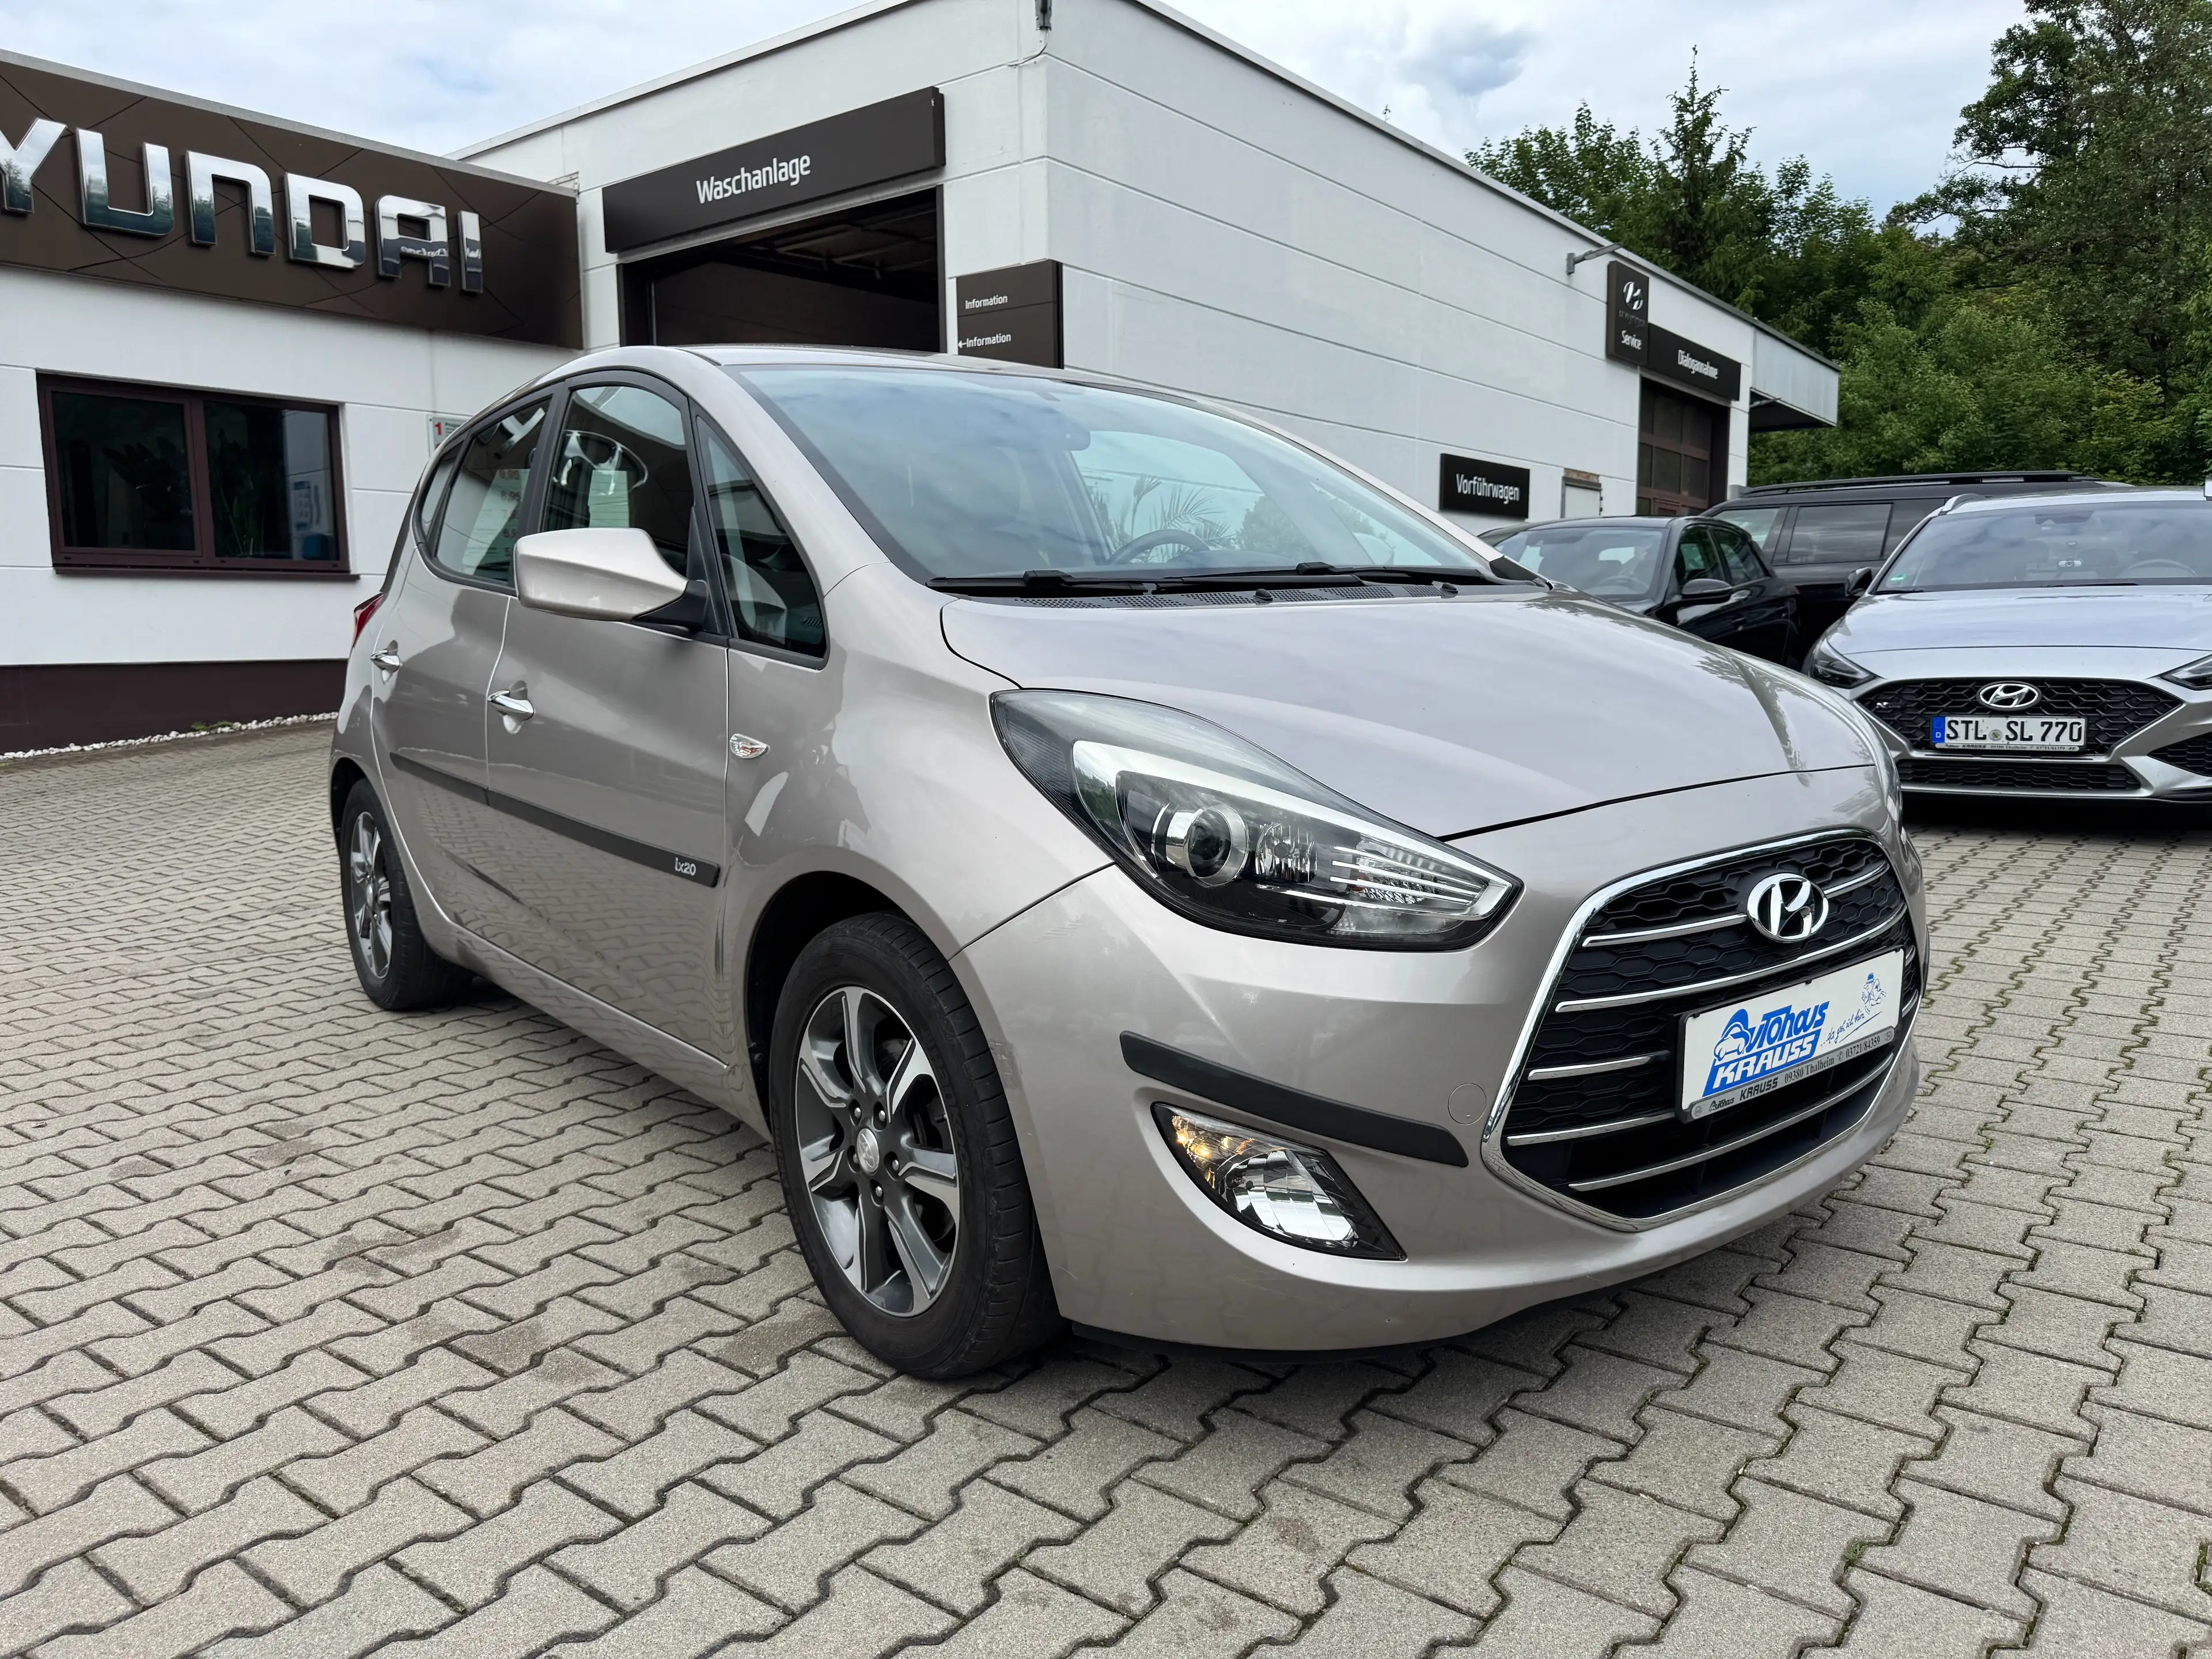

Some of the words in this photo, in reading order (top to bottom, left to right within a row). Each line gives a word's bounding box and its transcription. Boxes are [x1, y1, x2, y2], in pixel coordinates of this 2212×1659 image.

[696, 155, 811, 204] Waschanlage
[965, 294, 1008, 309] Information
[967, 333, 1012, 347] Information
[1621, 330, 1642, 350] Service
[1677, 349, 1719, 379] Dialogannahme
[1456, 473, 1520, 504] Vorführwagen
[1946, 719, 1987, 741] STL
[2005, 721, 2033, 741] SL
[2040, 721, 2082, 742] 770
[1713, 1034, 1816, 1089] KRAUSS
[1740, 1077, 1778, 1101] KRAUSS
[1785, 1067, 1804, 1084] 09380
[1805, 1056, 1834, 1074] Thalheim
[1846, 1036, 1880, 1059] 03721/84359
